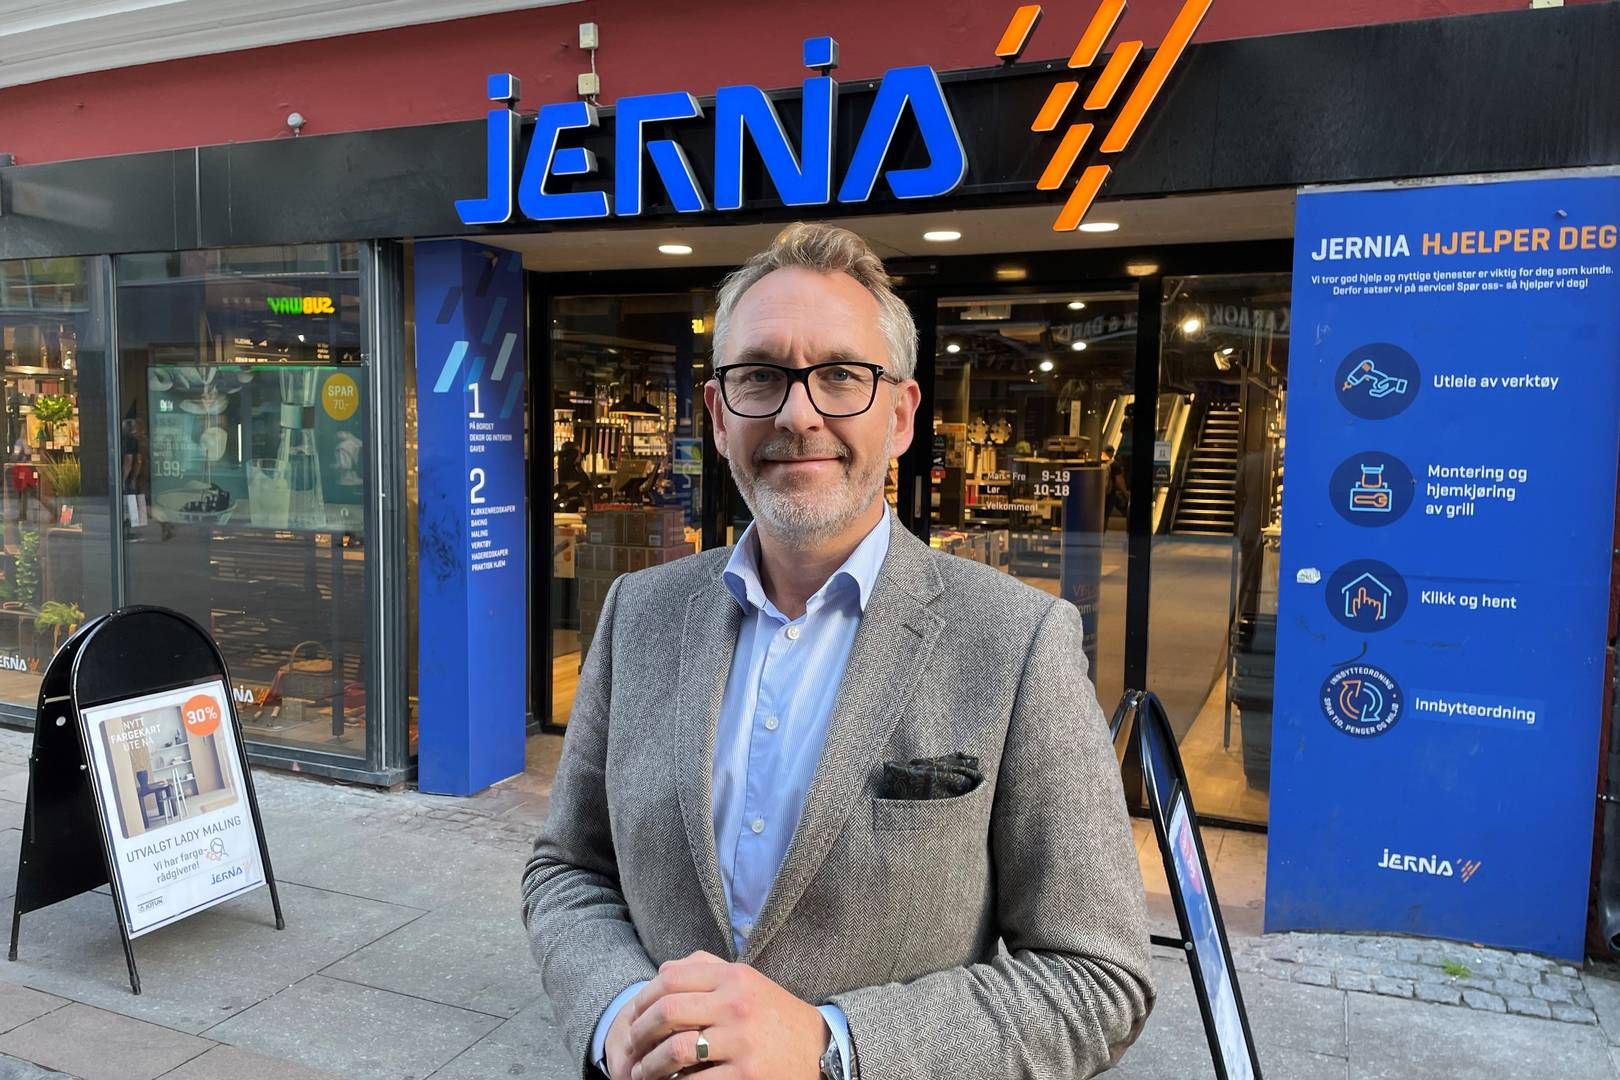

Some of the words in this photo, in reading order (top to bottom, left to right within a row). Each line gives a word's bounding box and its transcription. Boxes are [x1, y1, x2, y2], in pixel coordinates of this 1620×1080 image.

[453, 36, 969, 225] JERNIA
[1311, 234, 1410, 261] JERNIA
[1422, 228, 1550, 255] HJELPER
[1559, 225, 1617, 250] DEG
[1311, 275, 1320, 284] Vi
[1322, 275, 1338, 284] tror
[1341, 273, 1358, 285] god
[1360, 273, 1382, 284] hjelp
[1384, 273, 1396, 283] og
[1398, 271, 1431, 283] nyttige
[1433, 269, 1476, 281] tjenester
[1478, 271, 1488, 279] er
[1490, 267, 1517, 279] viktig
[1519, 266, 1533, 277] for
[1535, 266, 1554, 278] deg
[1556, 267, 1578, 276] som
[1580, 264, 1614, 275] kunde.
[1333, 285, 1361, 296] Derfor
[1363, 284, 1393, 294] satser
[1394, 284, 1402, 293] vi
[1404, 283, 1416, 295] på
[1418, 282, 1454, 293] service!
[1457, 281, 1479, 293] Spør
[1482, 281, 1503, 290] oss-
[1506, 279, 1518, 290] så
[1520, 279, 1553, 291] hjelper
[1556, 280, 1564, 289] vi
[1567, 278, 1588, 290] deg!
[328, 384, 353, 397] SPAR
[1433, 374, 1477, 388] Utleie
[1480, 376, 1497, 387] av
[1501, 374, 1559, 389] verktøy
[468, 383, 485, 418] 1
[1042, 470, 1070, 482] 9-19
[1428, 465, 1503, 481] Montering
[1508, 469, 1527, 482] og
[469, 467, 486, 504] 2
[987, 485, 1000, 494] Lør
[1034, 484, 1070, 496] 10-18
[1427, 484, 1516, 500] hjemkjøring
[986, 501, 1038, 511] Velkommen!
[1426, 505, 1442, 515] av
[1446, 503, 1474, 518] grill
[1421, 591, 1456, 605] Klikk
[1460, 595, 1477, 609] og
[1482, 594, 1517, 609] hent
[0, 655, 27, 671] ERNIA
[1330, 667, 1394, 690] INNBYTTEORDNING
[186, 705, 218, 725] 30%
[1324, 697, 1335, 716] SPAR
[1345, 724, 1376, 735] PENGER
[1376, 721, 1388, 732] OG
[1415, 697, 1536, 724] Innbytteordning
[121, 717, 145, 731] NYTT
[110, 724, 161, 745] FARGEKART
[126, 838, 172, 863] UTVALGT
[174, 829, 201, 847] LADY
[202, 815, 242, 837] MALING
[153, 862, 164, 872] Vi
[164, 857, 179, 869] har
[1378, 848, 1454, 876] JERNIA
[210, 866, 243, 885] JERNIA
